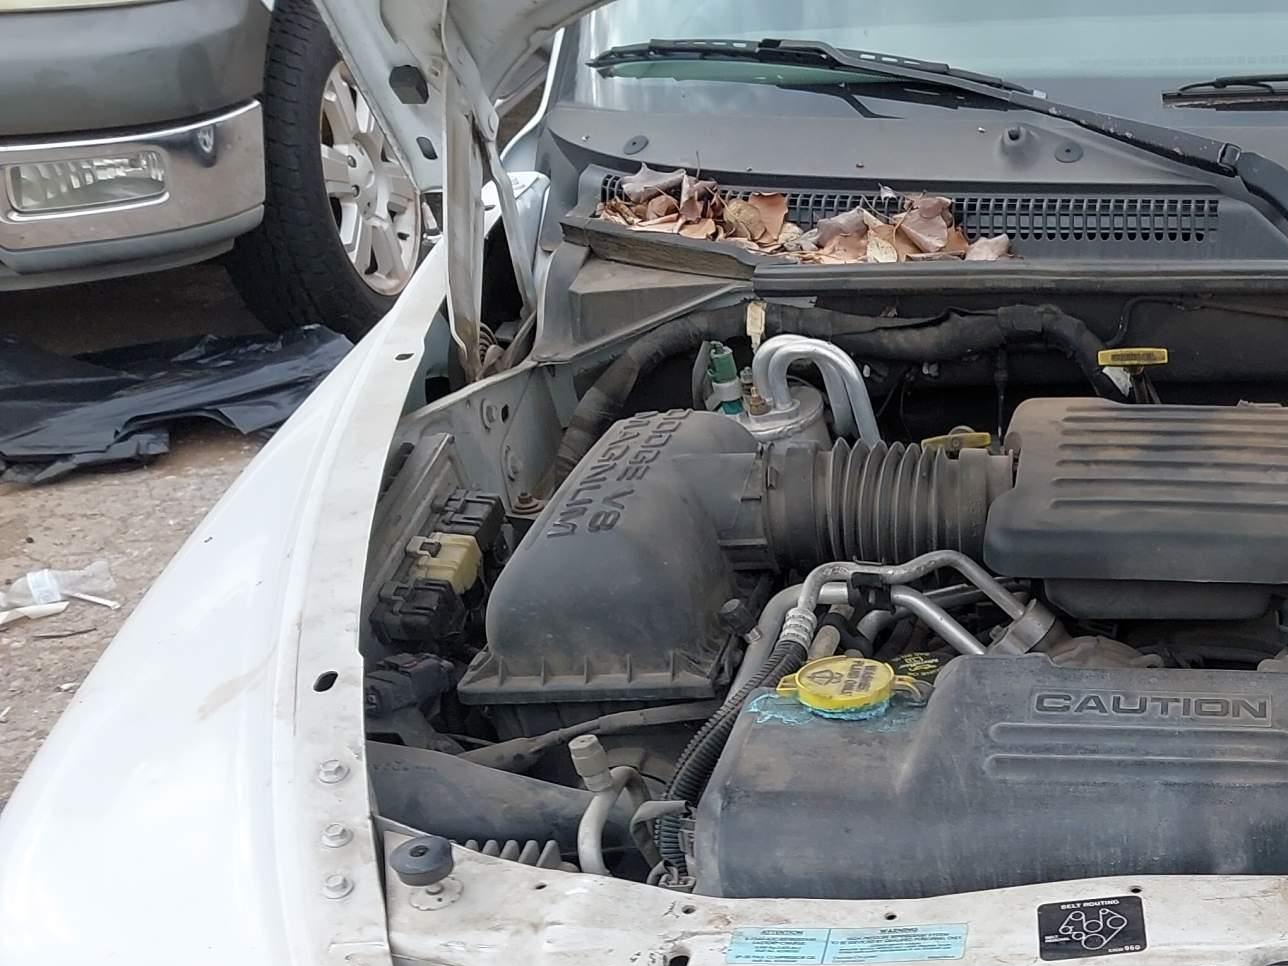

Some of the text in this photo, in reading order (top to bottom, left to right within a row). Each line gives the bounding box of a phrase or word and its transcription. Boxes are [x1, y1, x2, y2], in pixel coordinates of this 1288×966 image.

[547, 410, 660, 539] MAGNUM
[587, 408, 693, 533] DODGE V8
[1034, 693, 1268, 719] CAUTION
[1082, 899, 1120, 908] ROUTING
